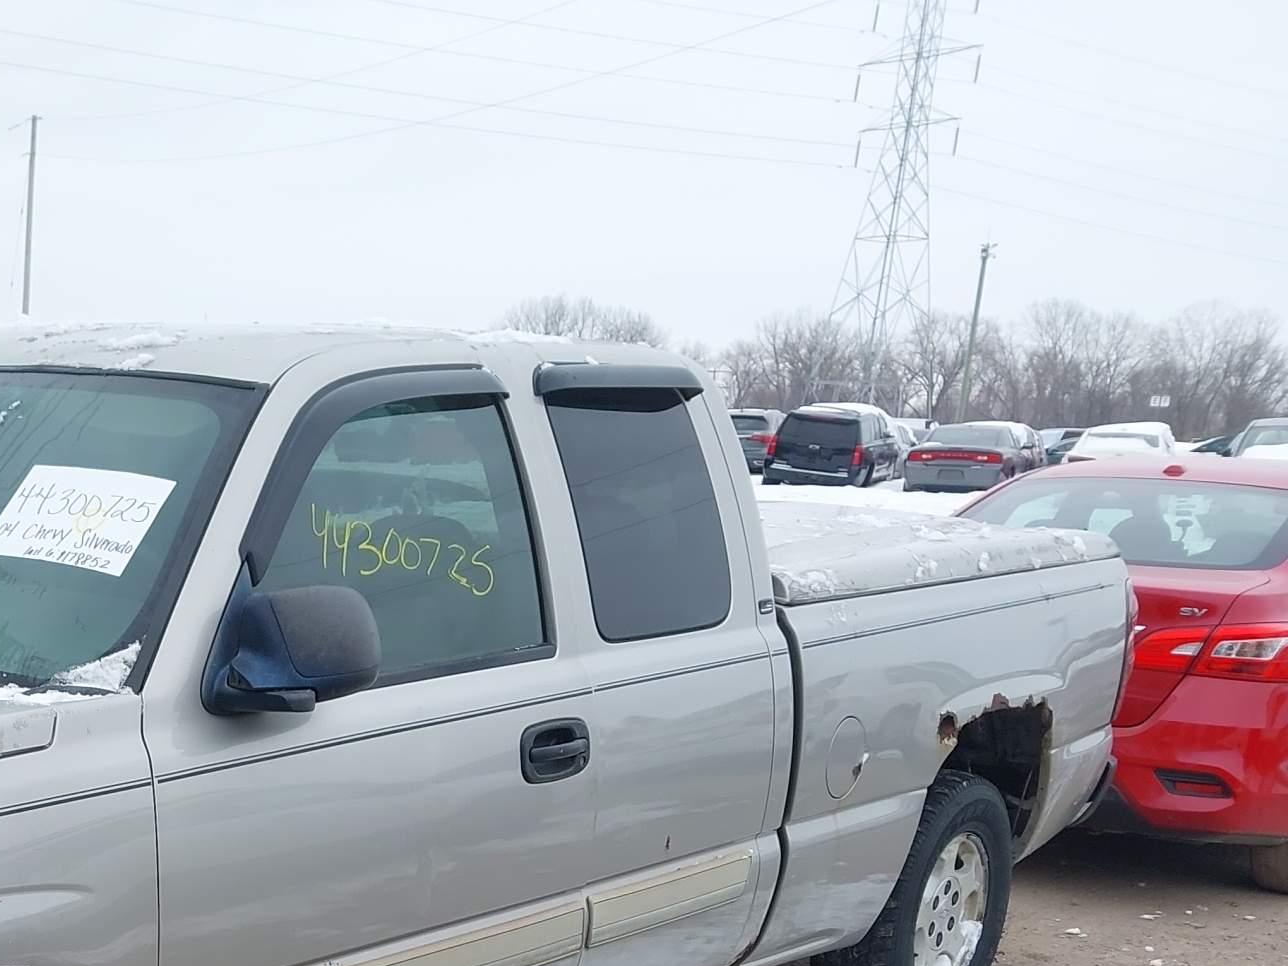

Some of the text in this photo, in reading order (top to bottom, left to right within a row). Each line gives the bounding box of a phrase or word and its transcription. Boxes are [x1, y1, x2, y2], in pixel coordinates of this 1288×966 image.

[17, 483, 158, 523] 44300725
[22, 523, 73, 547] Chevy
[73, 528, 134, 555] Silverado
[311, 503, 494, 596] 44300725
[1179, 607, 1209, 617] SV
